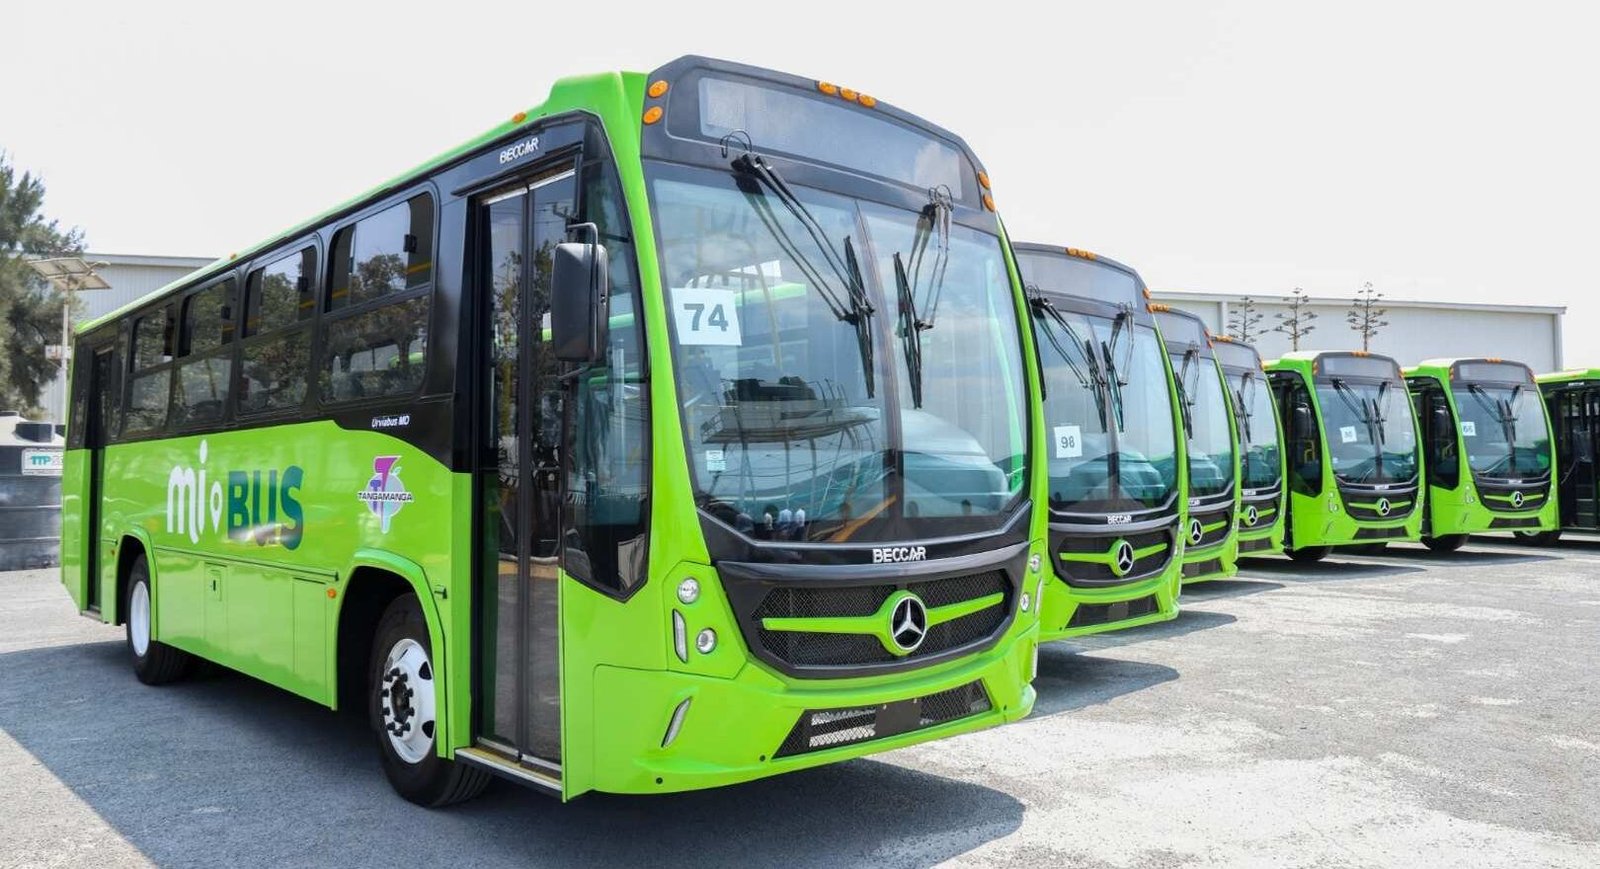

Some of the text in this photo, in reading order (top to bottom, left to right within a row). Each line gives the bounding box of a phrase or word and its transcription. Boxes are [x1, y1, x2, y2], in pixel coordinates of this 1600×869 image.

[499, 137, 539, 164] BECCAR
[683, 303, 729, 332] 74
[1060, 435, 1075, 449] 98
[31, 455, 51, 465] TTP
[358, 492, 413, 501] TANGAMANGA
[227, 465, 304, 550] BUS
[872, 546, 927, 563] BECCAR
